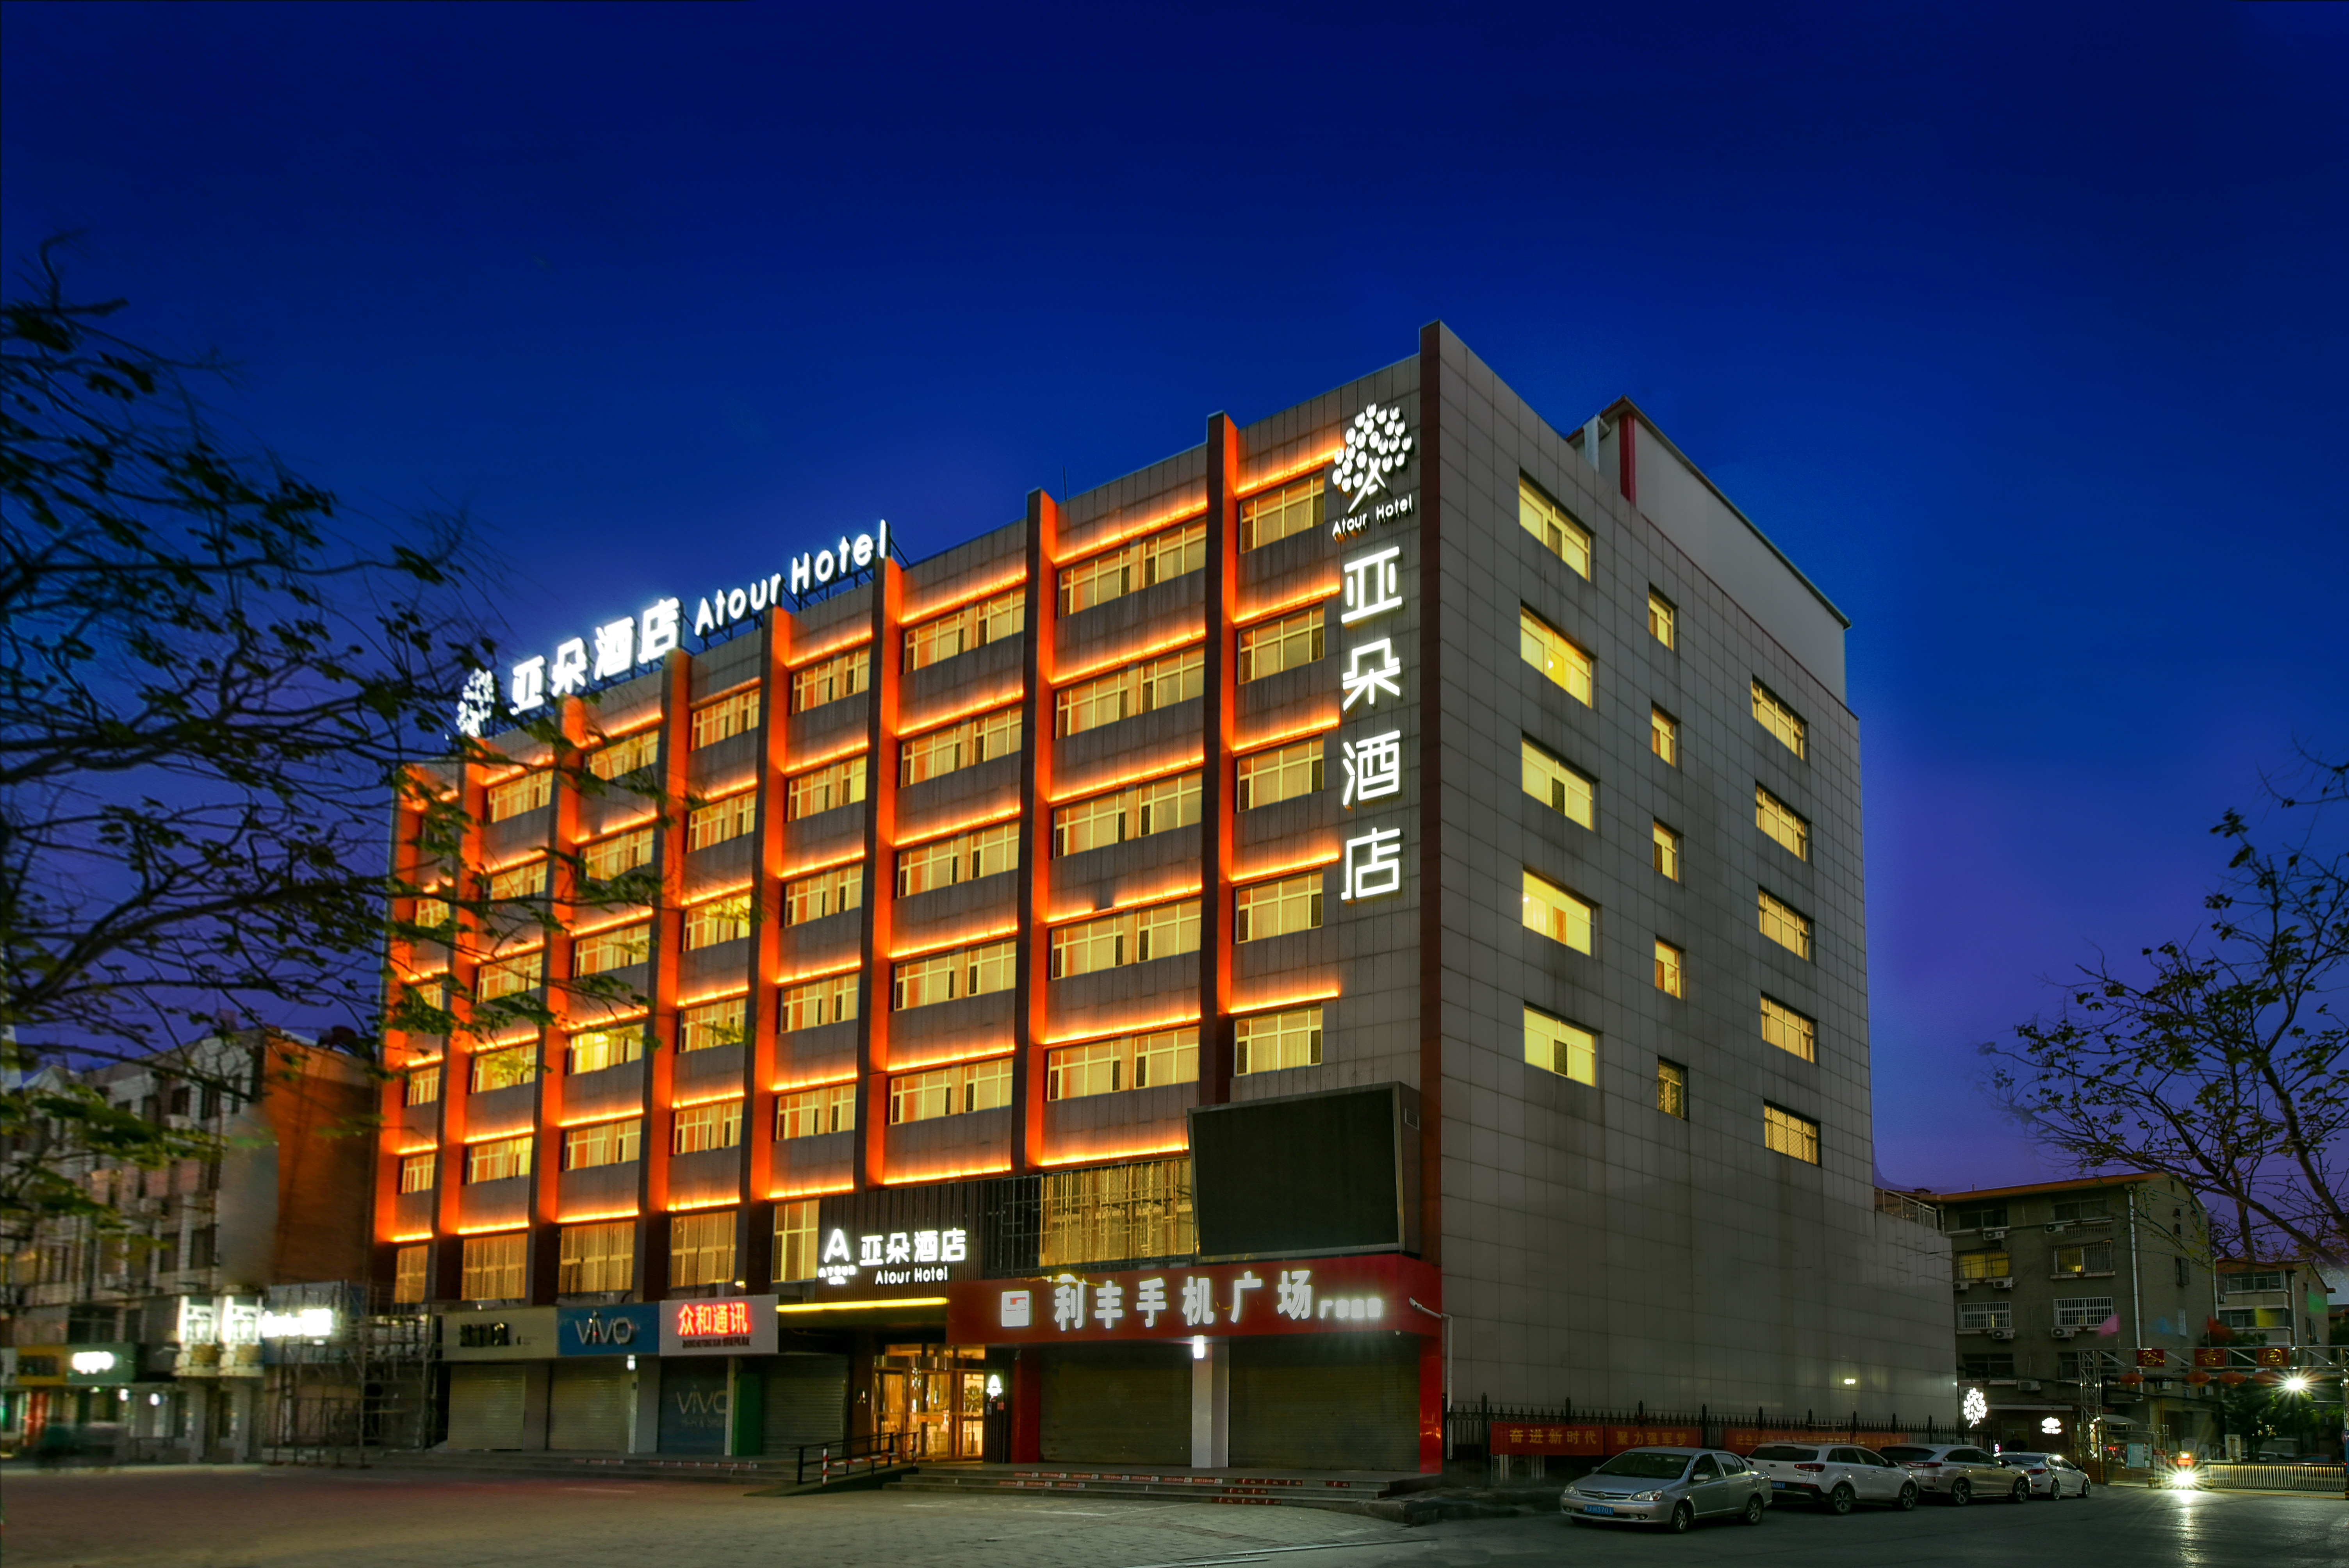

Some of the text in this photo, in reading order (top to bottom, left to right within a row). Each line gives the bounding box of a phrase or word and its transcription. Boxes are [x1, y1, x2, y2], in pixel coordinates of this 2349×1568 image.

[1332, 493, 1413, 537] Atour Hotel
[509, 519, 887, 716] 亚朵酒店 Atour Hotel
[1341, 546, 1403, 900] 亚朵酒店
[859, 1227, 966, 1267] 亚朵酒店
[875, 1265, 948, 1285] Atour Hotel
[678, 1302, 751, 1335] 众和通讯
[1055, 1270, 1312, 1331] 利丰手机广场
[574, 1310, 632, 1345] vivo
[1510, 1428, 1597, 1445] 奋进新时代
[1616, 1431, 1687, 1446] 聚力强军梦
